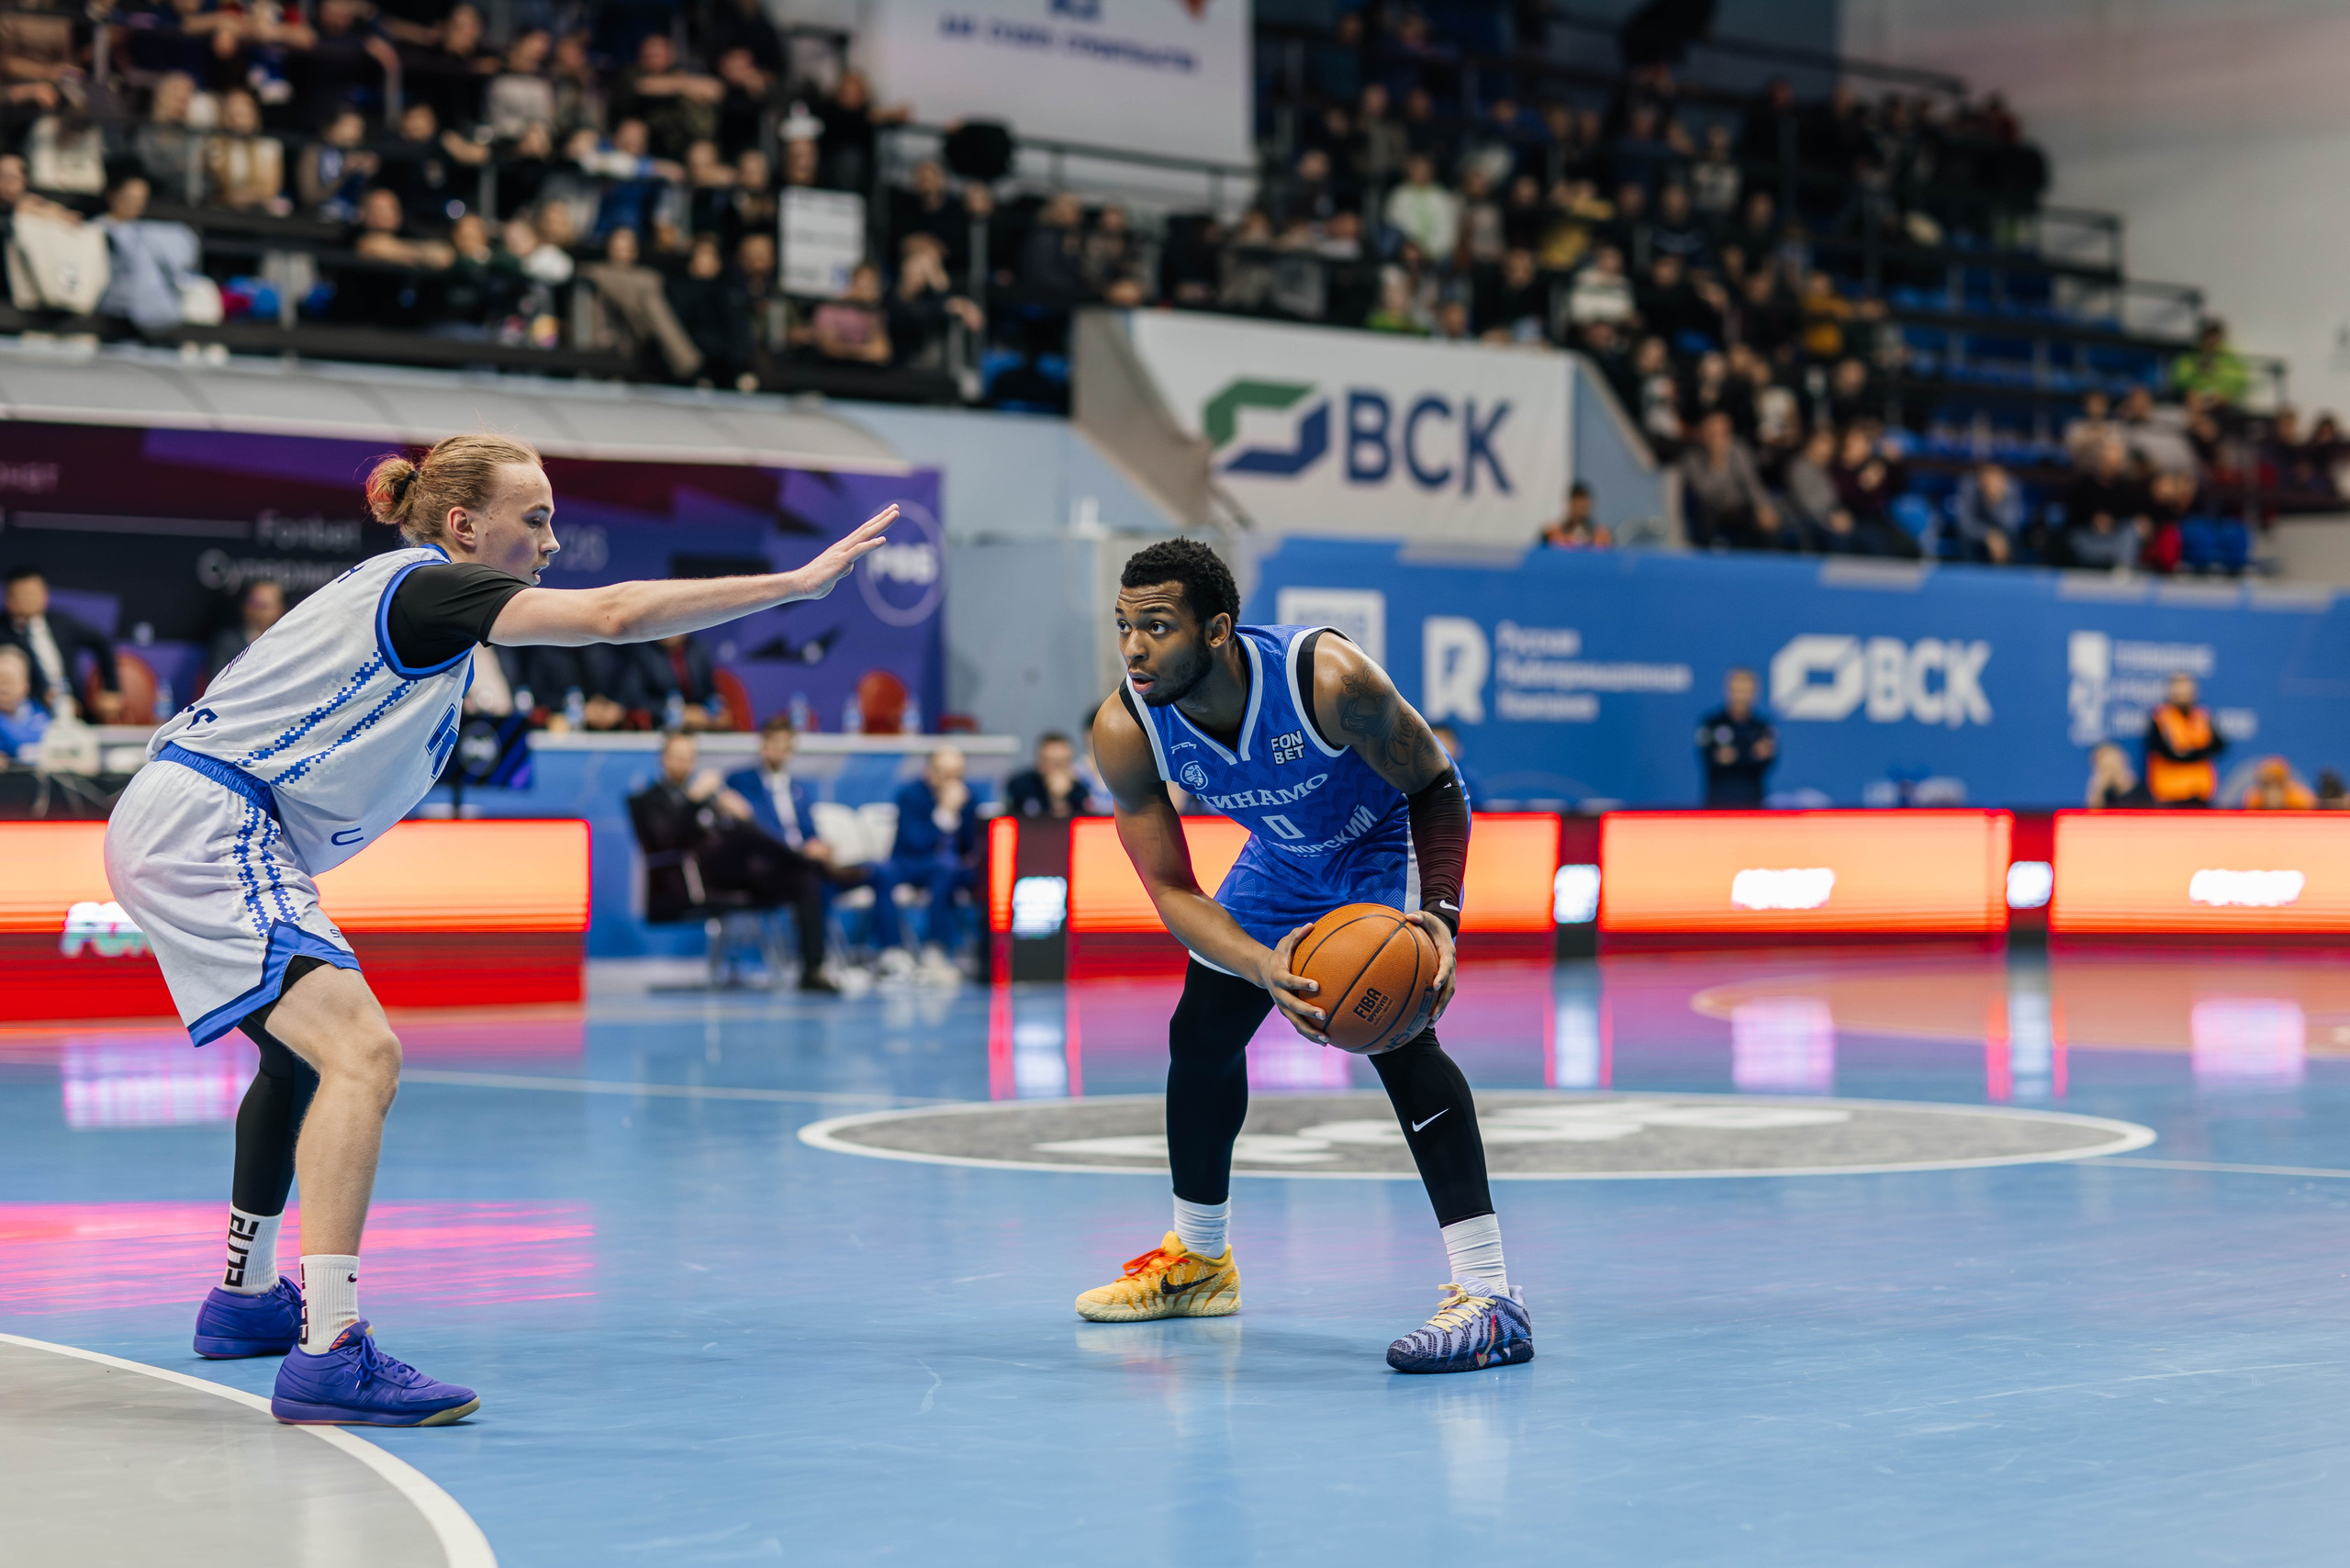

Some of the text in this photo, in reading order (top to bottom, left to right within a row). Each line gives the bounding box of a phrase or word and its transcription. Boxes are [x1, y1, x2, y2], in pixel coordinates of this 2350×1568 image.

[1270, 730, 1304, 752] FON
[1274, 745, 1305, 765] BET
[1261, 814, 1306, 839] 0
[1353, 987, 1382, 1019] FIBA
